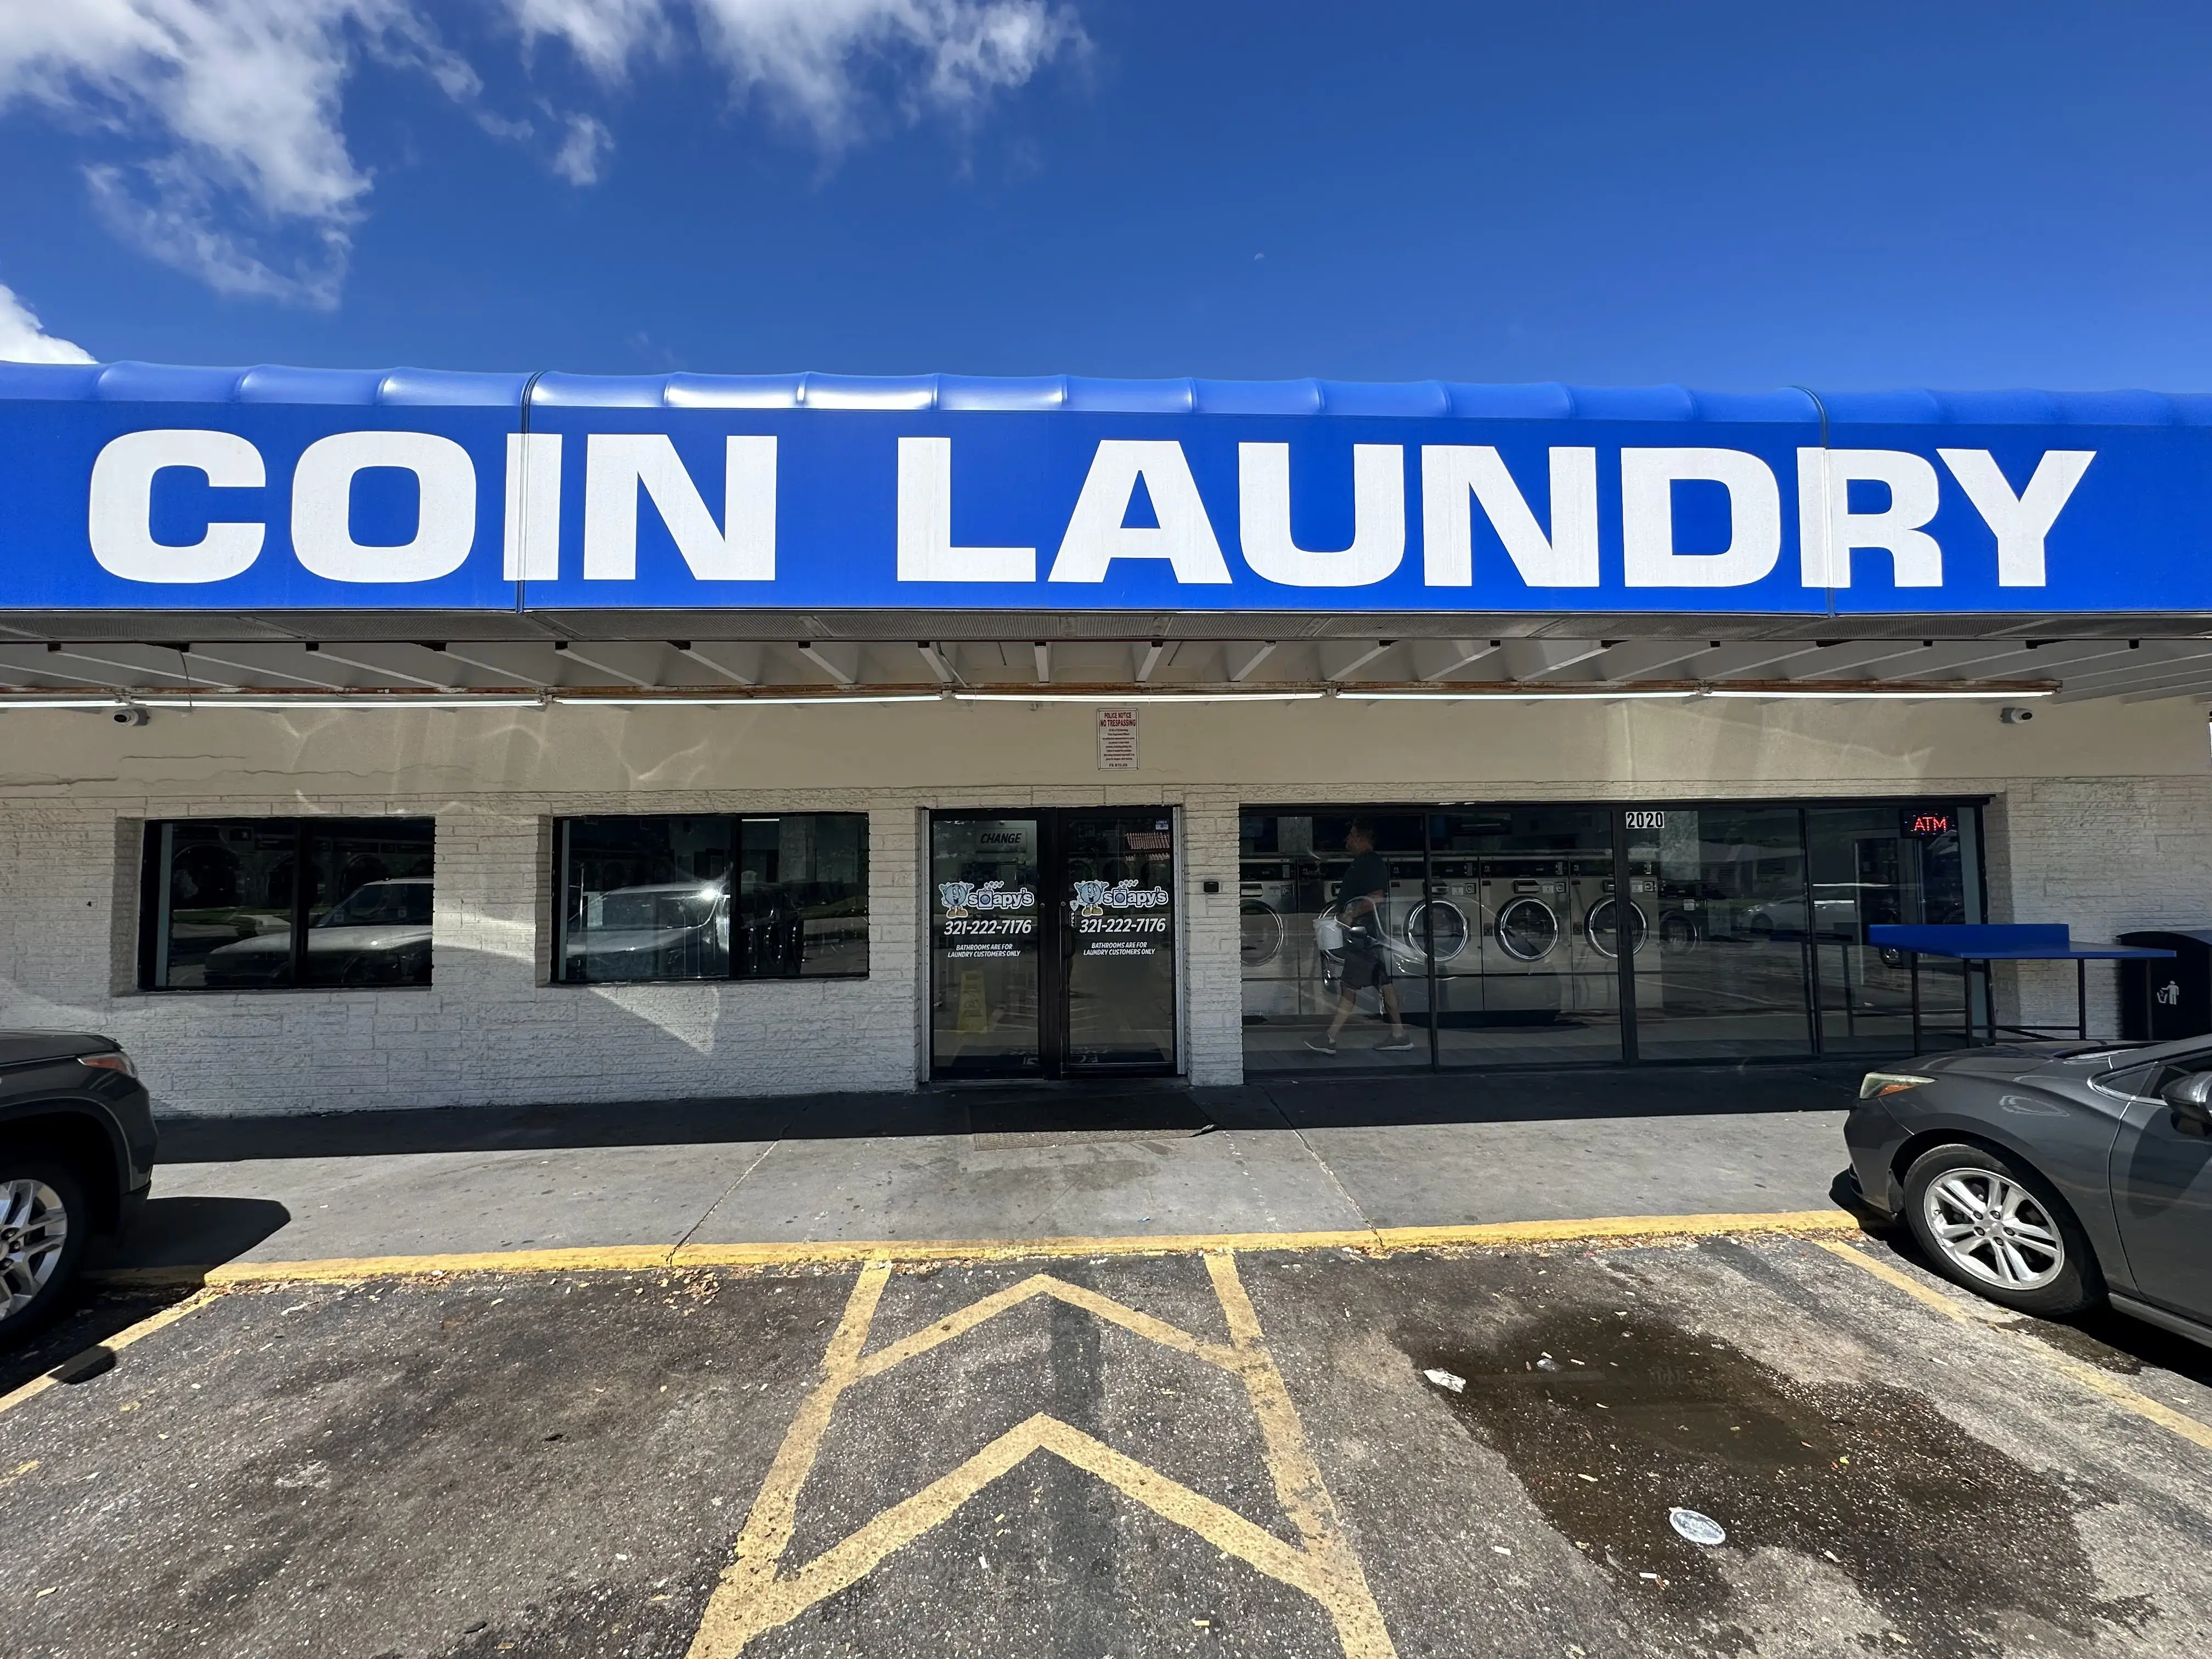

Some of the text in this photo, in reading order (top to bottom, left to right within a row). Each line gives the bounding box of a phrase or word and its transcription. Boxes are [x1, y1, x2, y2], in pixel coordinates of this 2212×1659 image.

[89, 429, 2096, 588] COIN LAUNDRY
[1627, 812, 1663, 828] 2020
[1914, 816, 1947, 831] ATM
[980, 833, 1022, 844] CHANGE
[944, 919, 1032, 935] 321-222-7176
[1079, 918, 1166, 933] 321-222-7176
